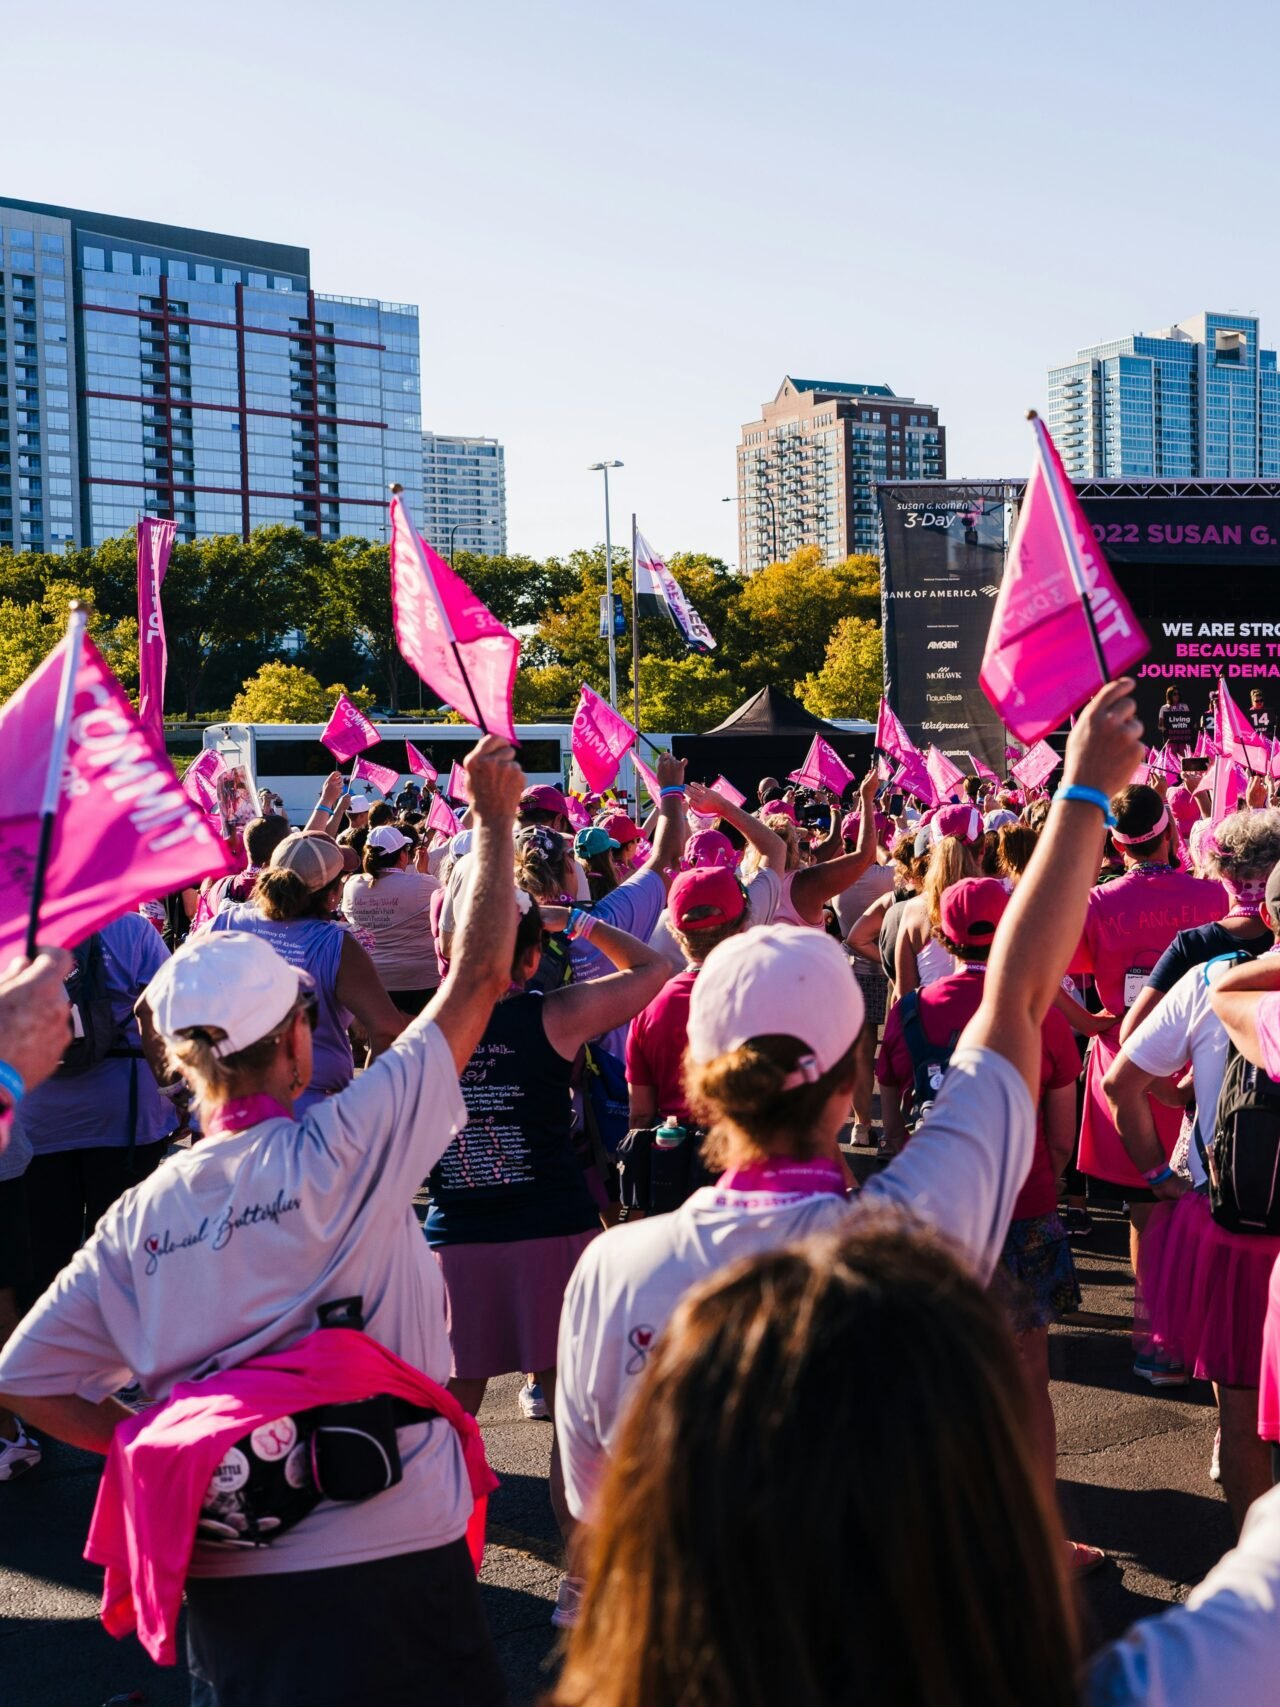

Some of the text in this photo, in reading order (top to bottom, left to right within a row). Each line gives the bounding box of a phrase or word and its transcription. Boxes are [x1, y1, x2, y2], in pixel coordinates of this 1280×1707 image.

[1093, 525, 1139, 542] 022
[1147, 524, 1241, 544] SUSAN
[1250, 526, 1277, 544] G.
[930, 590, 978, 598] AMERICA
[1162, 623, 1193, 636] WE
[1198, 623, 1235, 636] ARE
[928, 641, 958, 649] AMGEN
[1176, 644, 1262, 657] BECAUSE
[926, 672, 962, 680] MOHAWK
[1137, 664, 1224, 678] JOURNEY
[339, 702, 377, 738] COMMIT
[1251, 713, 1269, 726] 14
[922, 721, 970, 732] Walgreens
[1139, 905, 1204, 930] ANGEL
[211, 1188, 301, 1251] Butterflies
